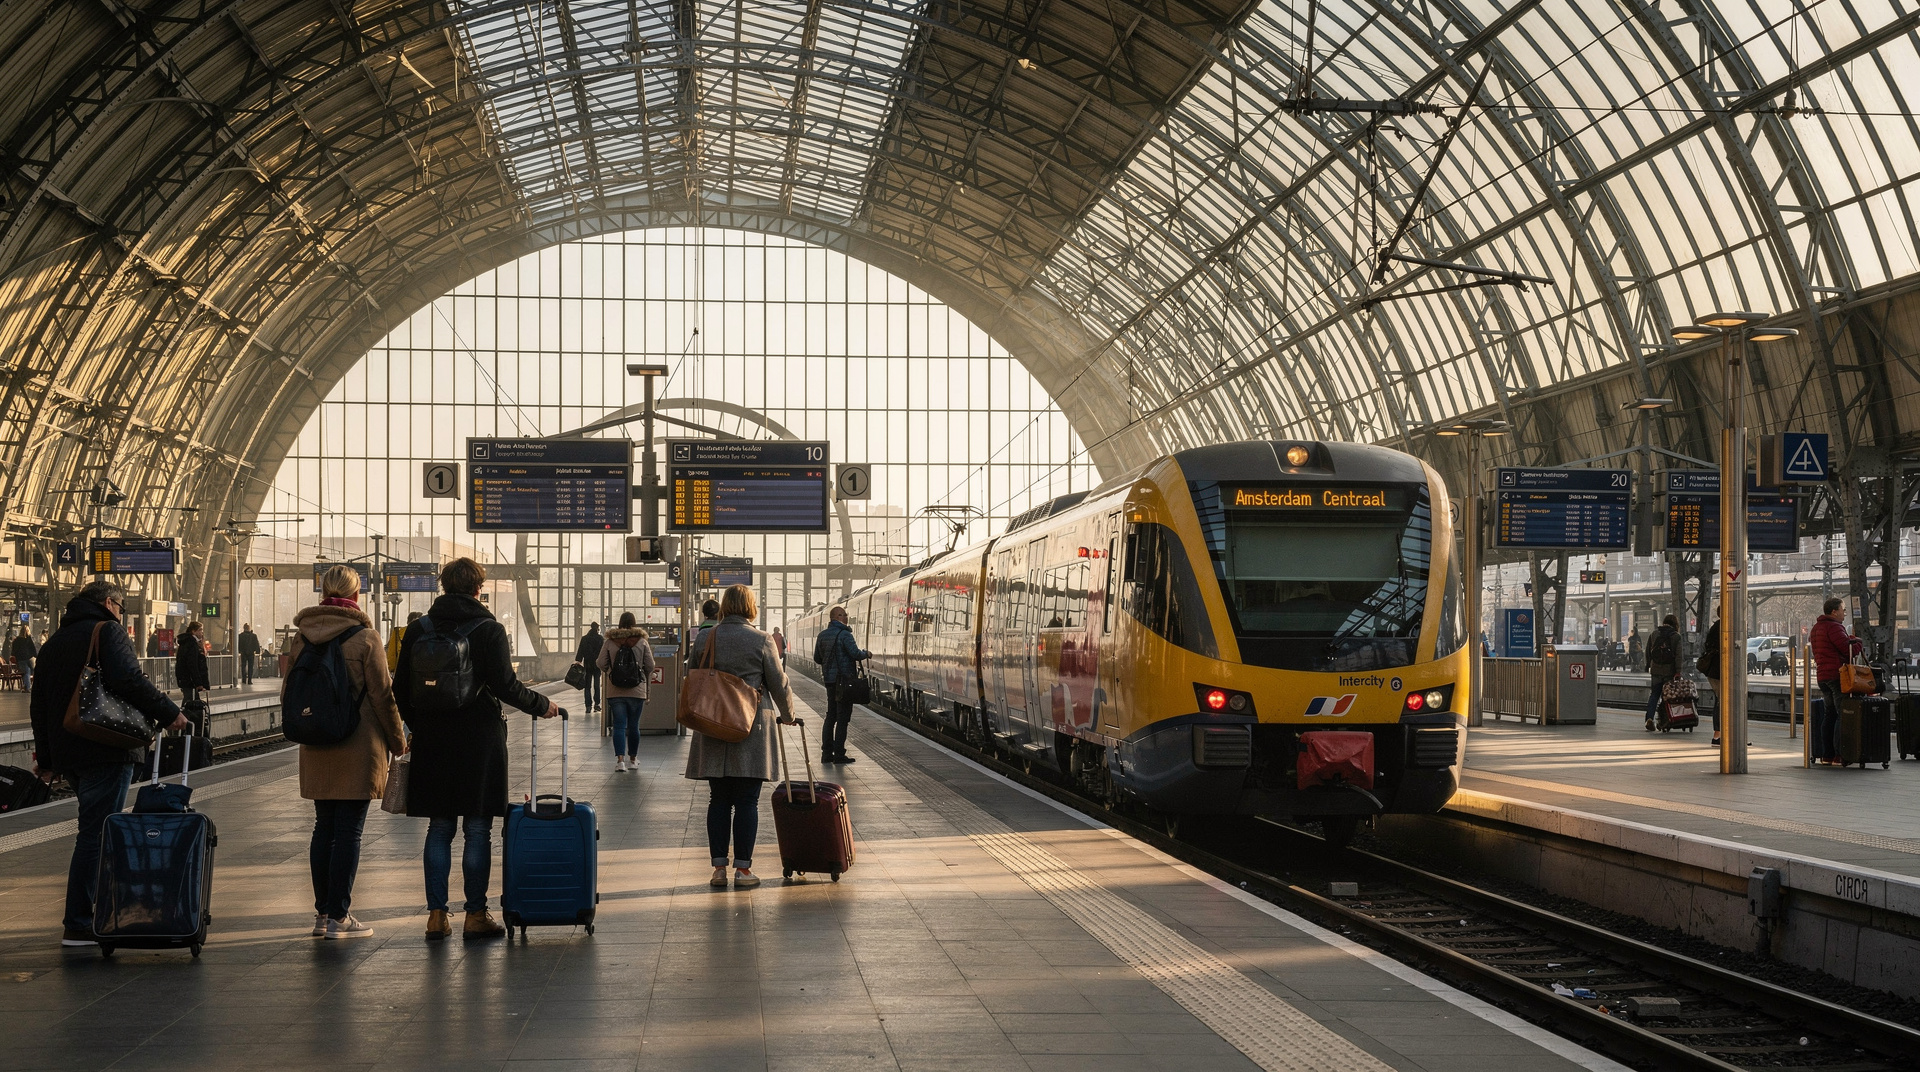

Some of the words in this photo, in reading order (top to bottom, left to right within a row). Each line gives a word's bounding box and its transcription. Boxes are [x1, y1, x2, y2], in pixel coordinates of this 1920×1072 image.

[805, 446, 823, 461] 10
[434, 471, 444, 490] 1
[848, 472, 857, 491] 1
[1611, 473, 1627, 487] 20
[1235, 489, 1312, 506] Amsterdam
[1323, 490, 1386, 507] Centraal
[61, 548, 72, 561] 4
[672, 566, 681, 578] 3
[1338, 675, 1385, 689] Intercity
